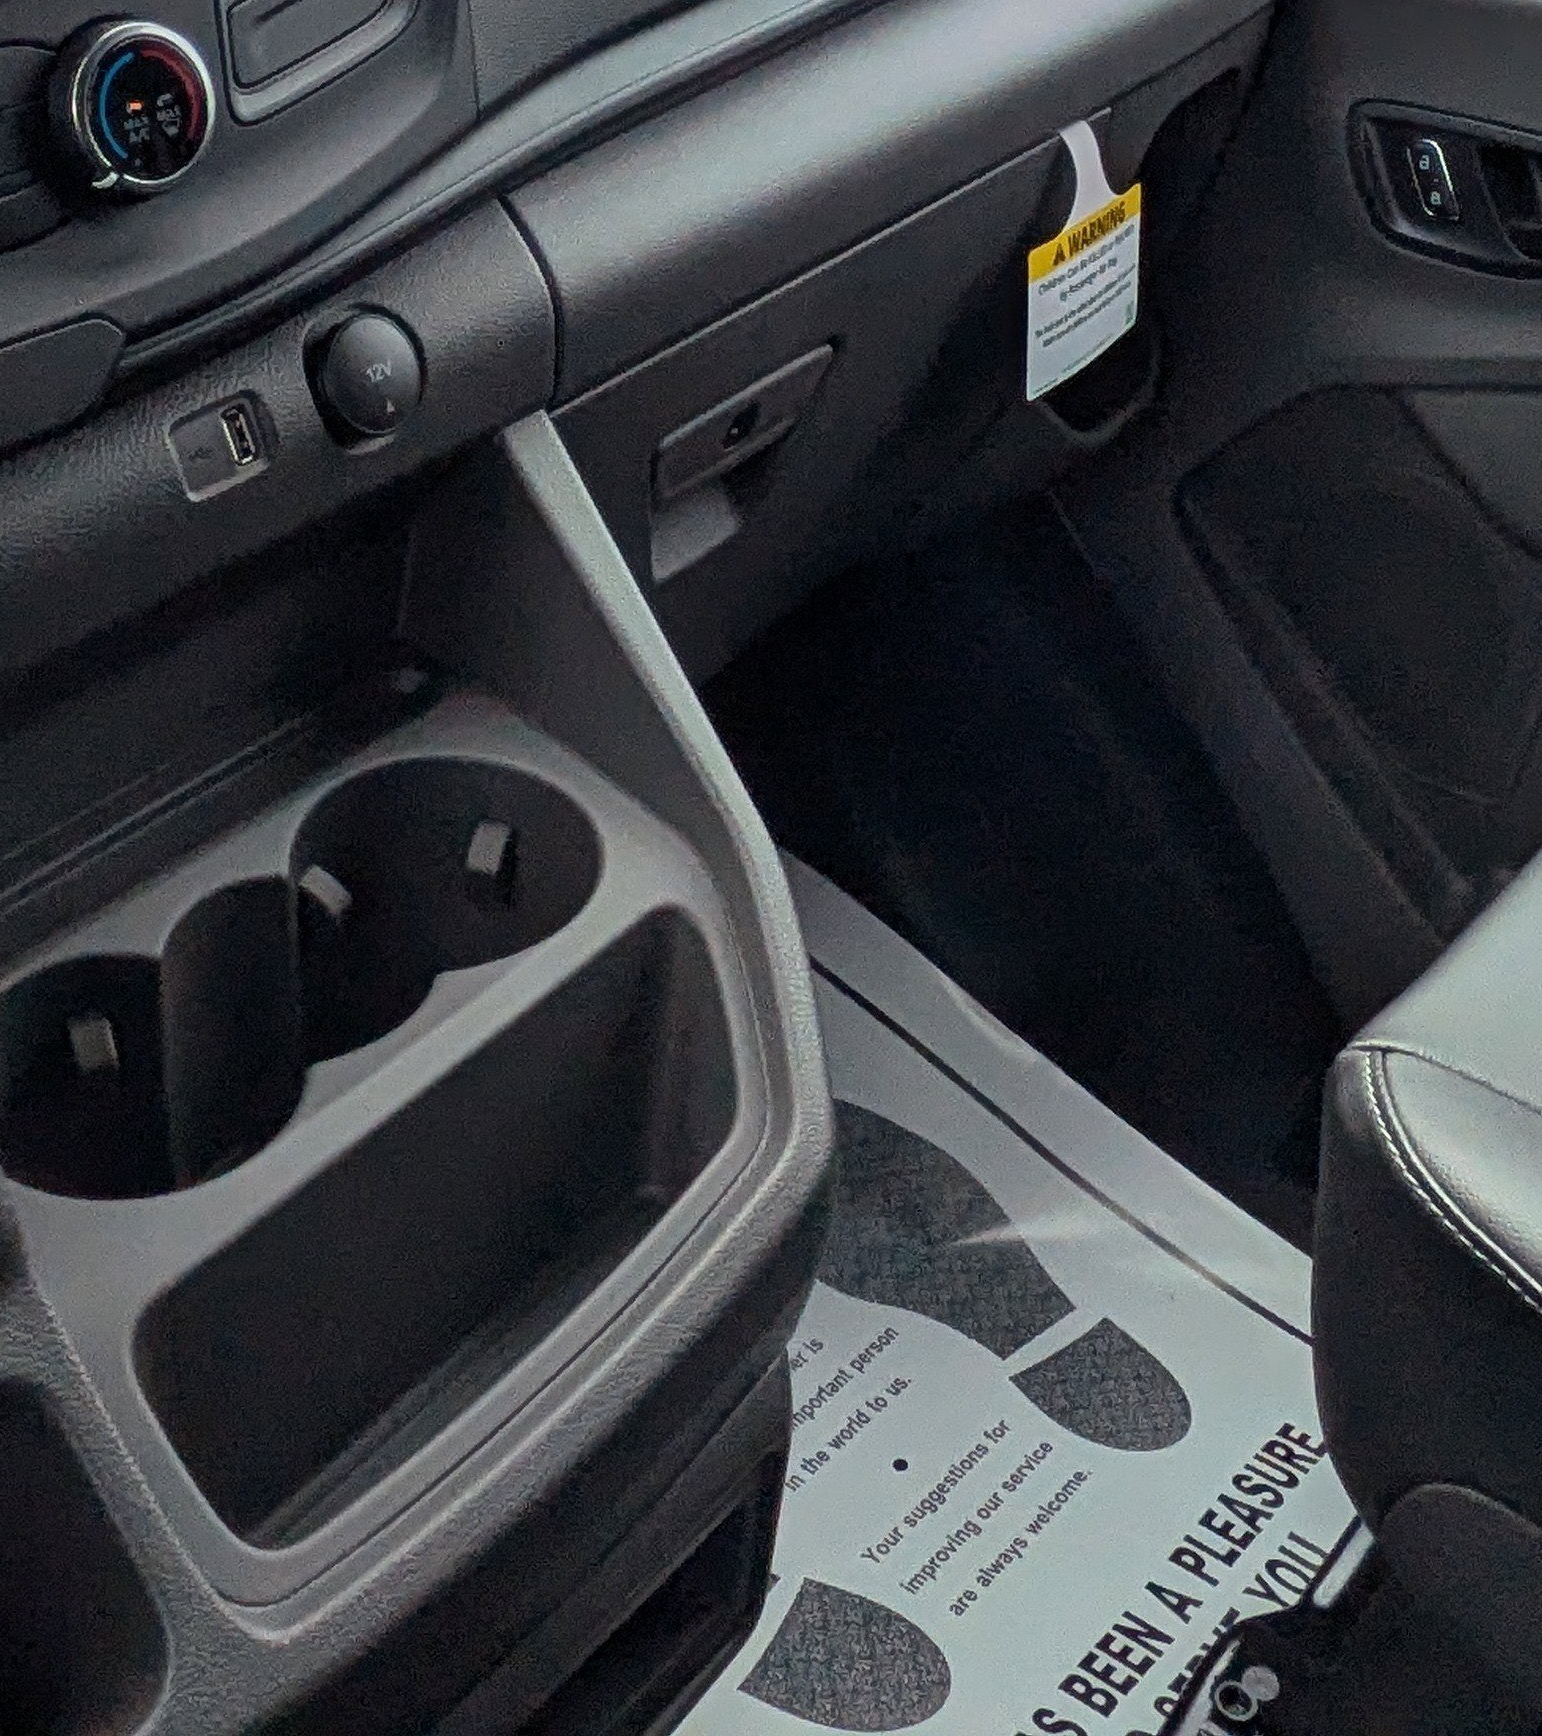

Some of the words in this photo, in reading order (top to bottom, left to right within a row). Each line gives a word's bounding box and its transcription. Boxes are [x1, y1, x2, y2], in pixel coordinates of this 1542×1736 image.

[1067, 200, 1126, 258] WARNING
[365, 359, 392, 383] 12V
[792, 1368, 855, 1430] mportant
[850, 1326, 900, 1374] person
[802, 1338, 824, 1355] is
[785, 1473, 806, 1492] in
[800, 1450, 830, 1475] the
[827, 1408, 871, 1450] world
[865, 1396, 888, 1413] to
[886, 1377, 912, 1397] us.
[860, 1526, 905, 1564] Your
[903, 1442, 989, 1528] suggestions
[983, 1419, 1011, 1445] for
[900, 1519, 983, 1595] improving
[976, 1491, 1005, 1521] our
[1002, 1441, 1054, 1493] service
[949, 1588, 979, 1617] are
[976, 1535, 1029, 1589] always
[1026, 1469, 1094, 1535] welcome.
[1168, 1422, 1329, 1587] PLEASURE
[1144, 1581, 1204, 1625] A
[1058, 1610, 1176, 1718] BEEN
